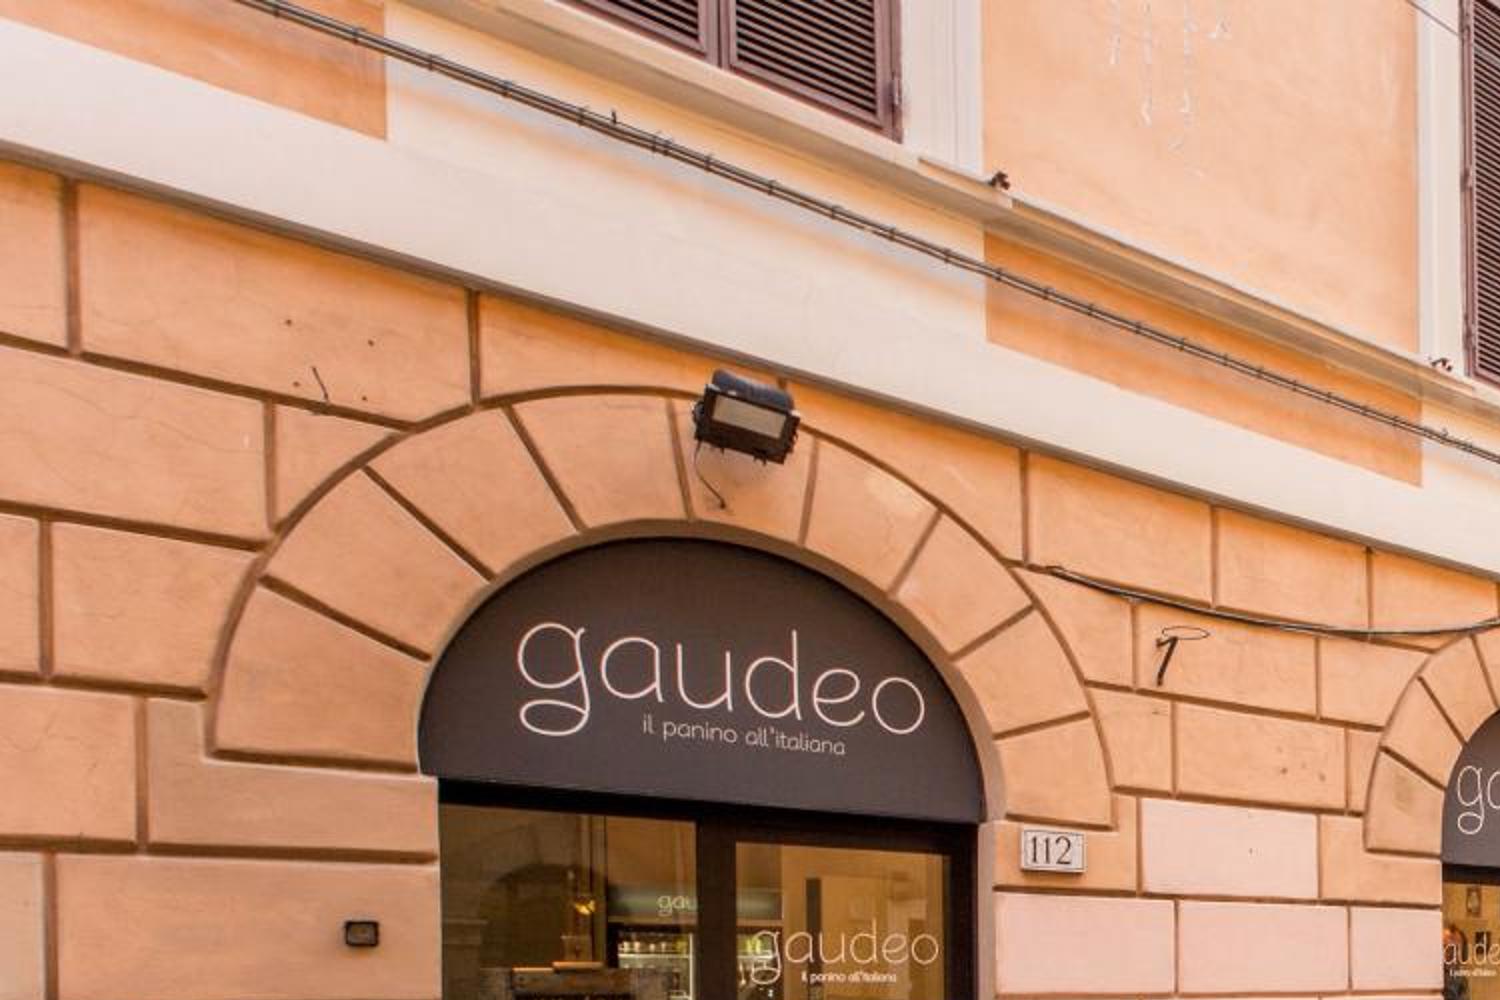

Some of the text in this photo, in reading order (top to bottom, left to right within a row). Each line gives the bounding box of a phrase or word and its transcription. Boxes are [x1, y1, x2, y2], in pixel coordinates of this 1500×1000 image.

[517, 622, 926, 737] gaudeo
[642, 714, 846, 756] il panino all'italiana
[1031, 835, 1072, 865] 112
[750, 917, 940, 985] gaudeo
